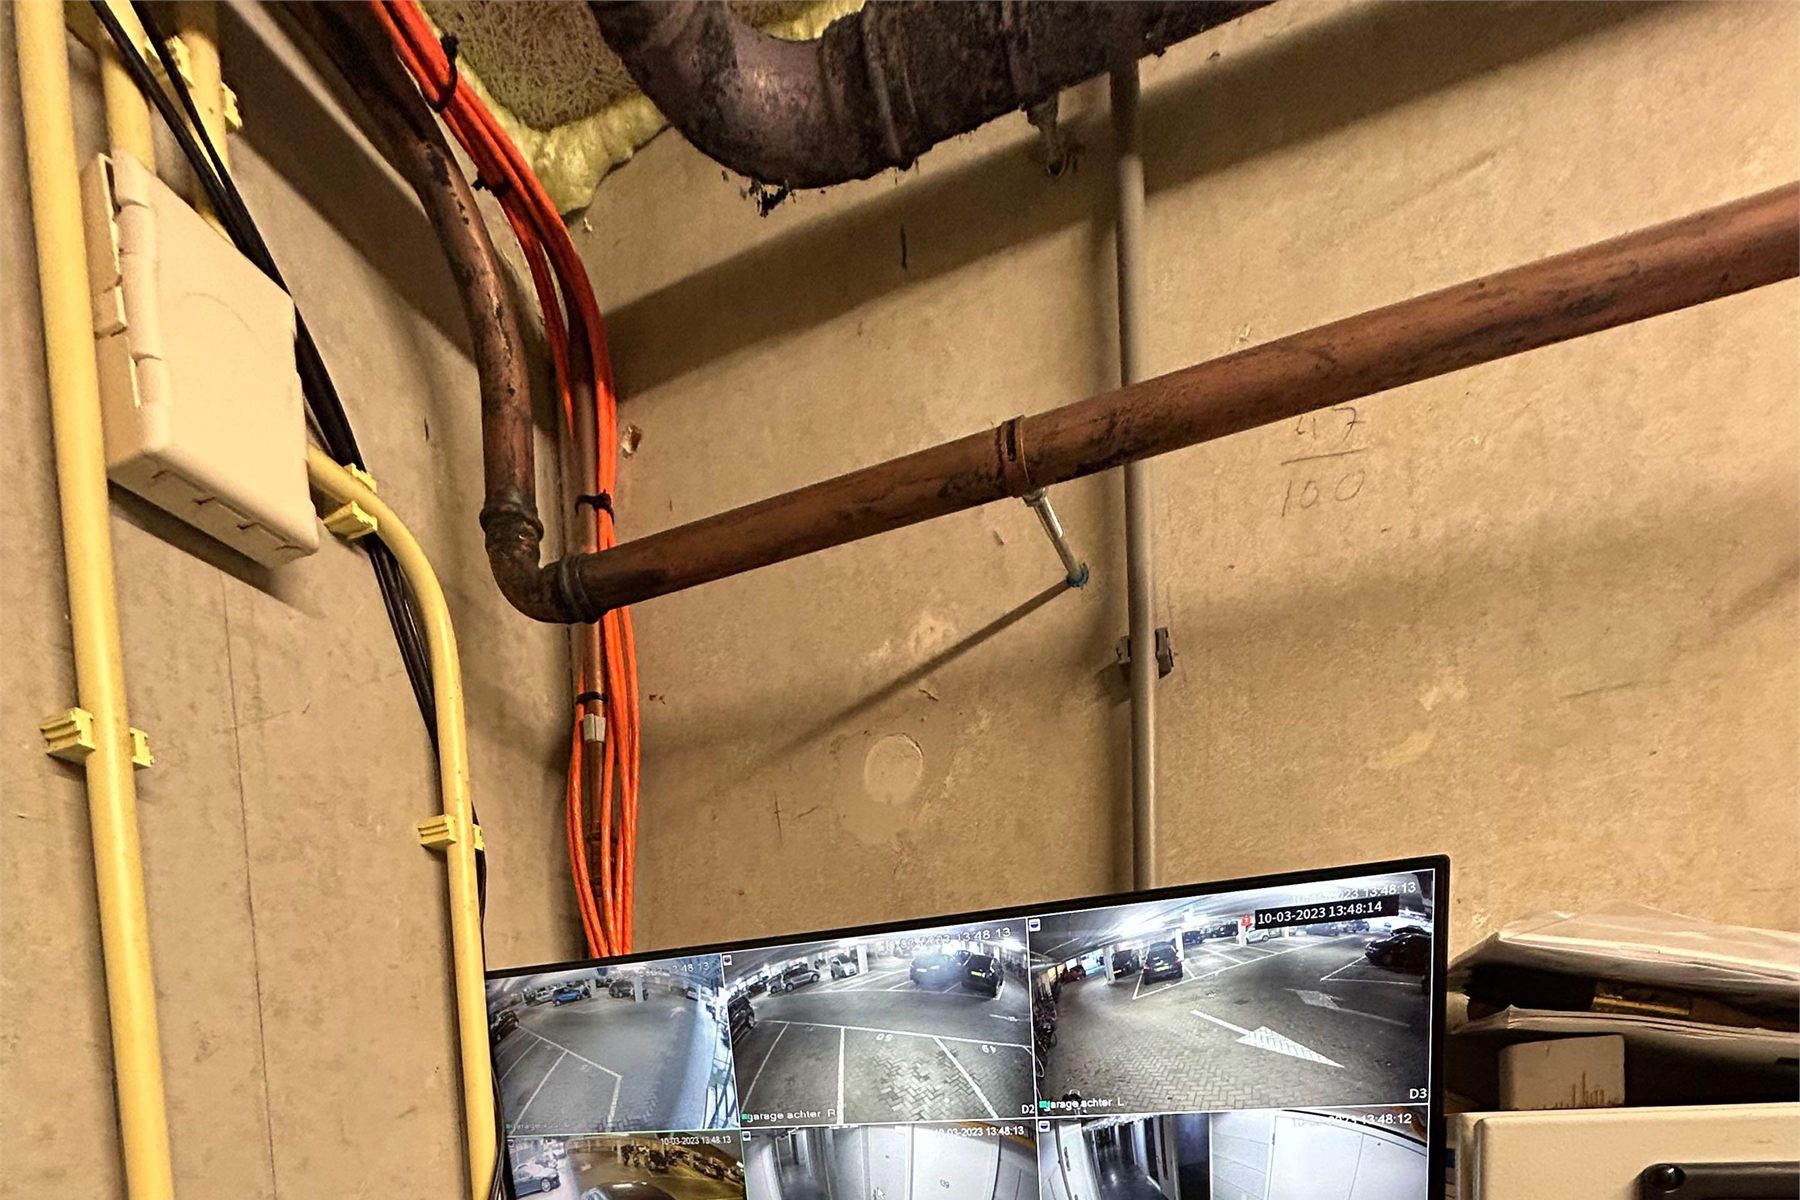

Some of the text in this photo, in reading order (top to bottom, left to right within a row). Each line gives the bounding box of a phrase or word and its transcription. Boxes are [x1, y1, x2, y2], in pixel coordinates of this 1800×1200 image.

[1281, 467, 1366, 518] 100
[1257, 901, 1383, 925] 10-03-2023 13:48:14
[1409, 1088, 1428, 1099] D3
[747, 1108, 836, 1123] garage achter R
[1021, 1104, 1035, 1114] D2
[986, 1125, 1025, 1136] 13:48:13
